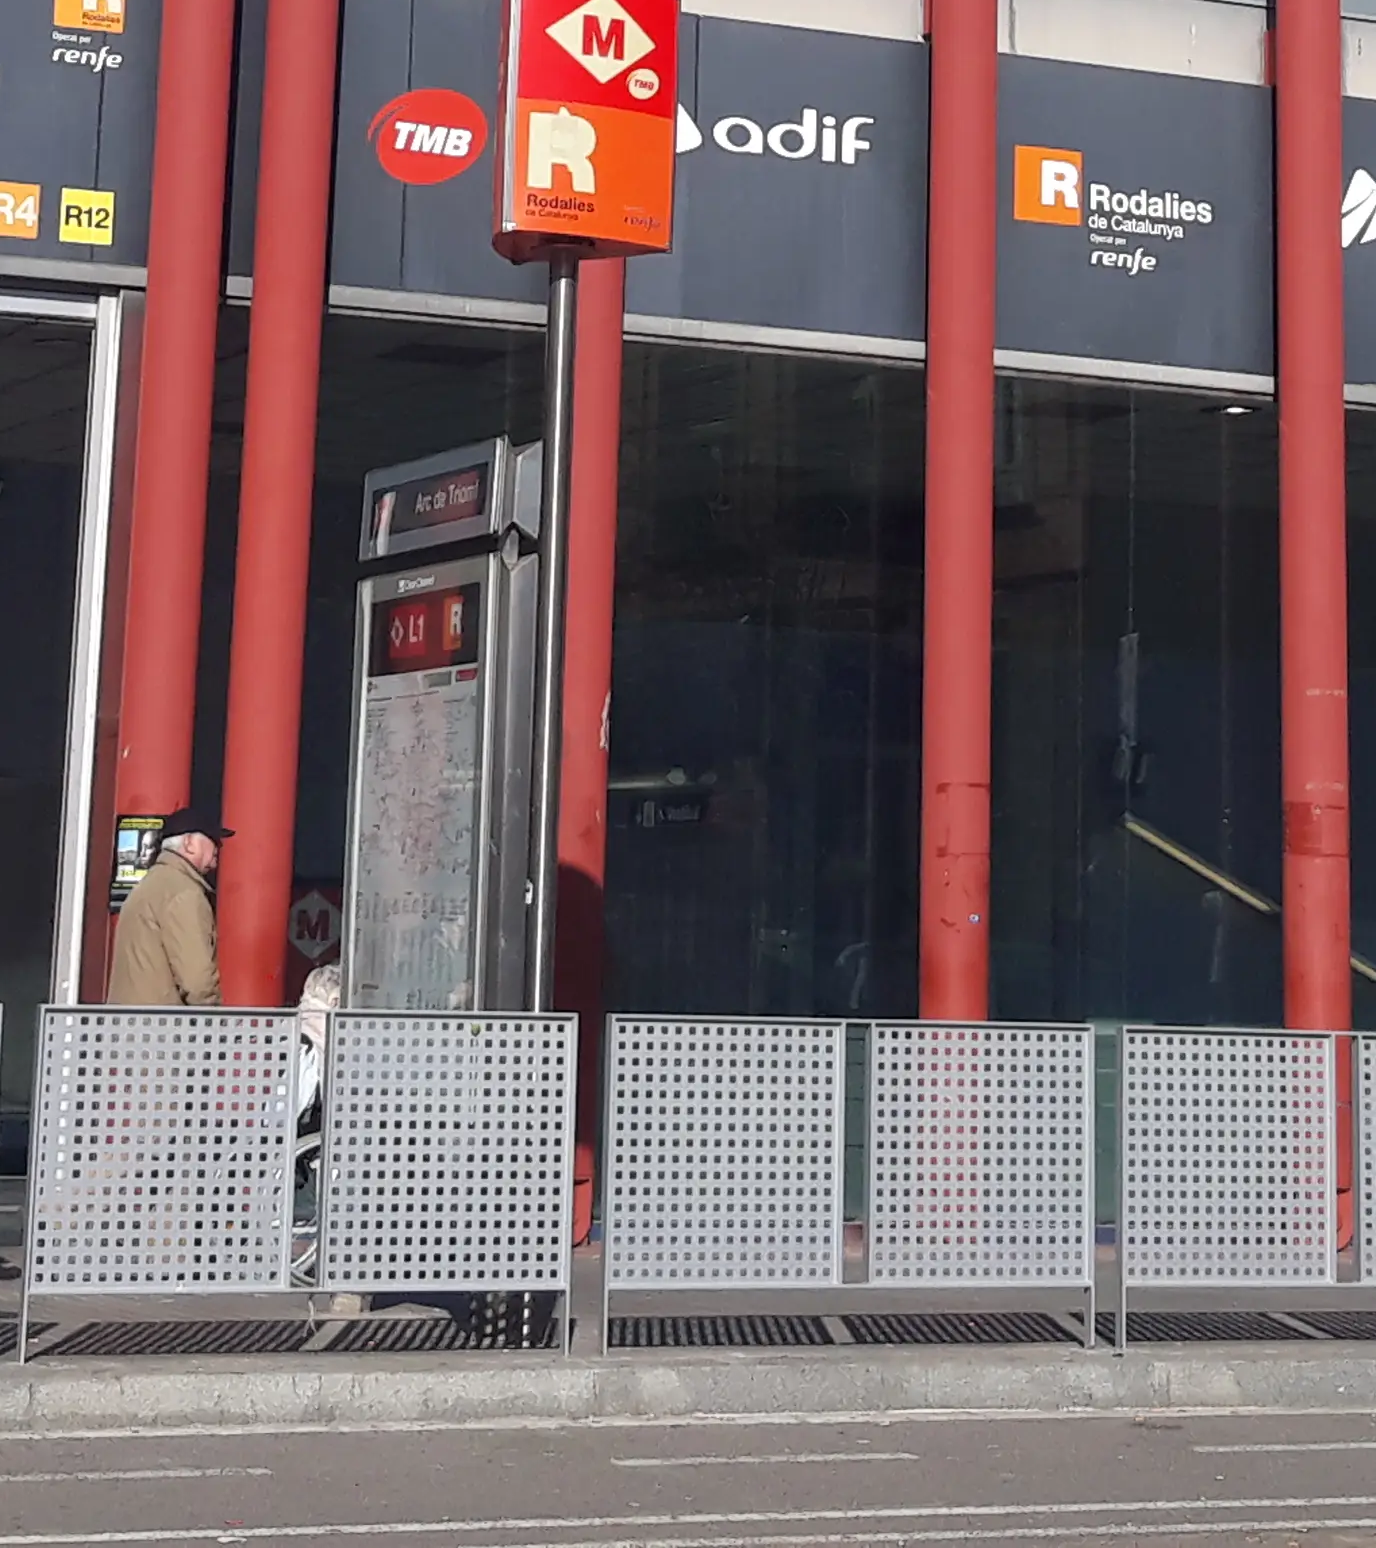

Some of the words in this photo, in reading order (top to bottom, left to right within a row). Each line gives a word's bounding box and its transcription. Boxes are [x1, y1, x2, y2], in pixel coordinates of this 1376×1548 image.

[582, 14, 625, 61] M
[52, 46, 122, 73] renfe
[633, 78, 654, 91] TMB
[394, 121, 473, 157] TMB
[712, 107, 874, 166] adif
[527, 109, 597, 195] R
[1041, 159, 1079, 209] R
[64, 205, 110, 229] R12
[526, 193, 595, 213] Rodalies
[1089, 183, 1213, 224] Rodalies
[1088, 214, 1108, 229] de
[1110, 215, 1184, 241] Catalunya
[1090, 247, 1157, 276] renfe
[414, 492, 432, 515] Arc
[433, 488, 447, 510] de
[409, 614, 424, 643] L1
[450, 603, 463, 636] R
[295, 908, 330, 940] M
